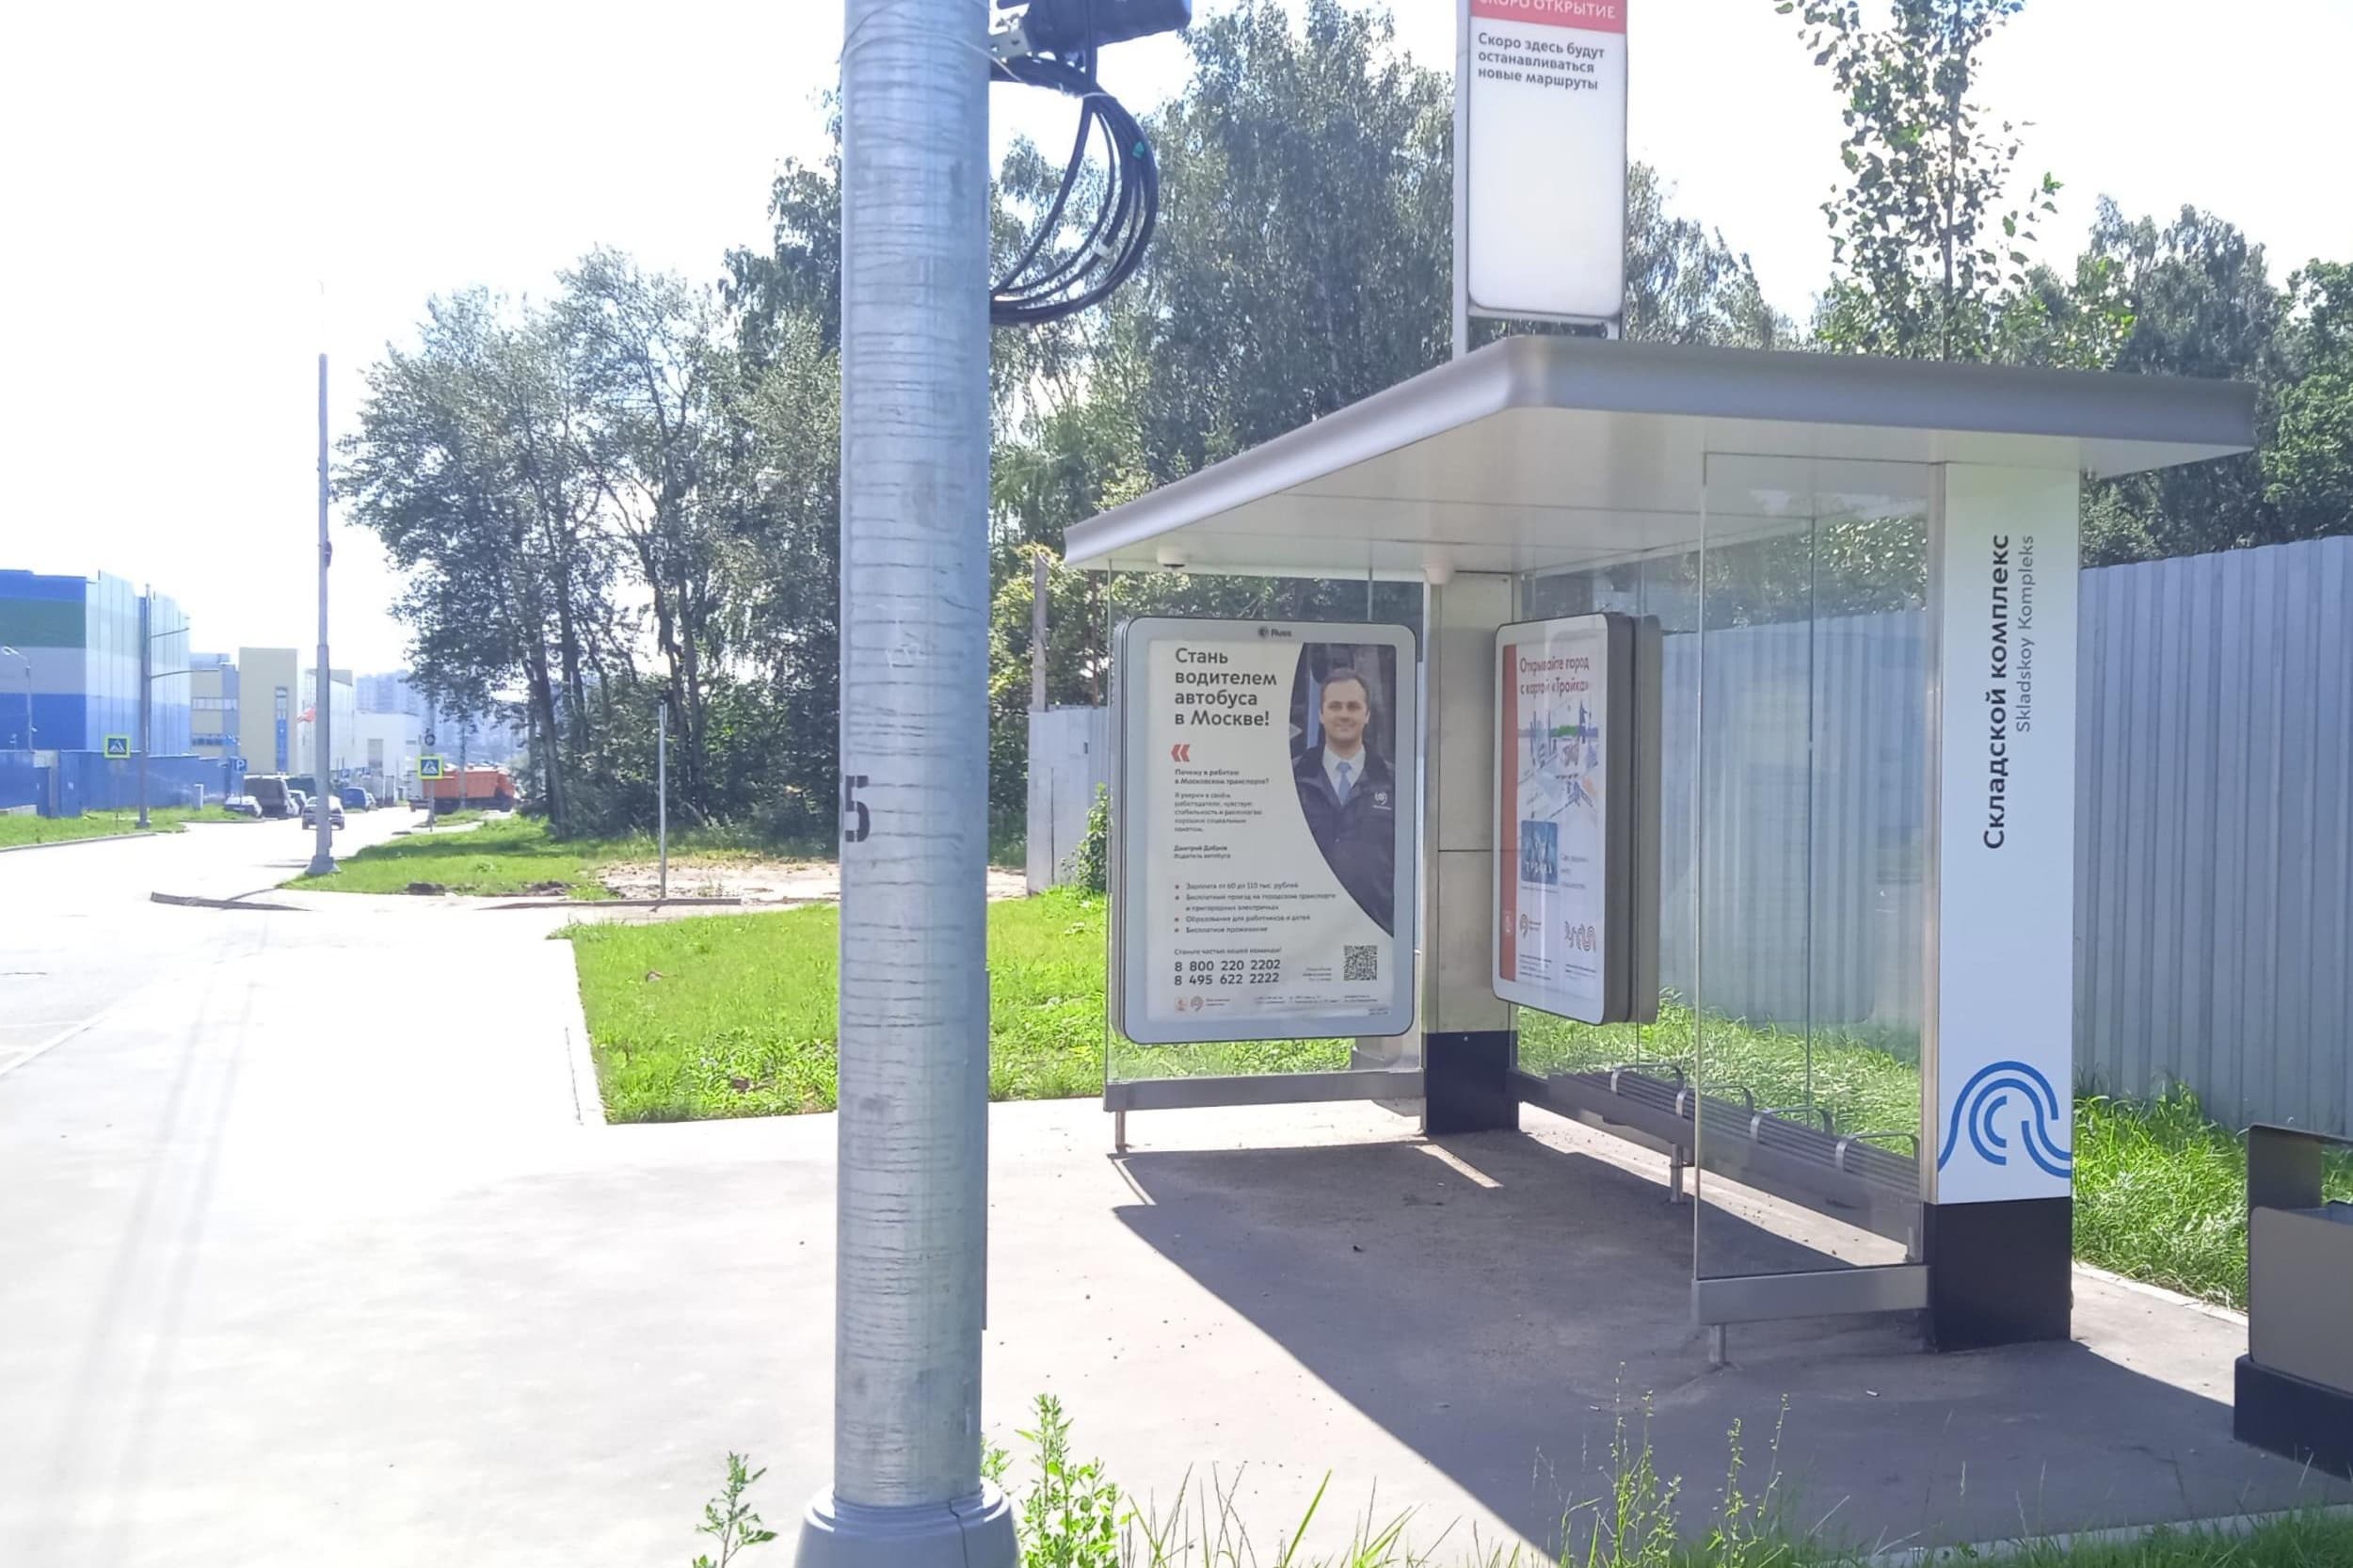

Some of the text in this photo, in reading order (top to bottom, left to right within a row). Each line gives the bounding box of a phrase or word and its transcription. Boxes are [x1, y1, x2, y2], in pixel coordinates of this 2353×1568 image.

[1533, 0, 1617, 19] ОТКРЫТИЕ
[1478, 32, 1605, 60] Скоро здесь будут
[1478, 50, 1594, 73] останавливаться
[1478, 68, 1598, 90] новые маршруты
[2016, 535, 2036, 733] Skladskoy Kompleks
[1175, 647, 1229, 664] Стань
[1565, 657, 1590, 674] город
[1175, 672, 1278, 687] водителем
[1175, 689, 1258, 709] автобуса
[1983, 534, 2009, 850] Складской комплекс
[1175, 710, 1270, 727] в Москве!
[845, 776, 871, 842] 5
[1175, 959, 1281, 972] 8 800 220 2202
[1174, 972, 1280, 985] 8 495 622 2222
